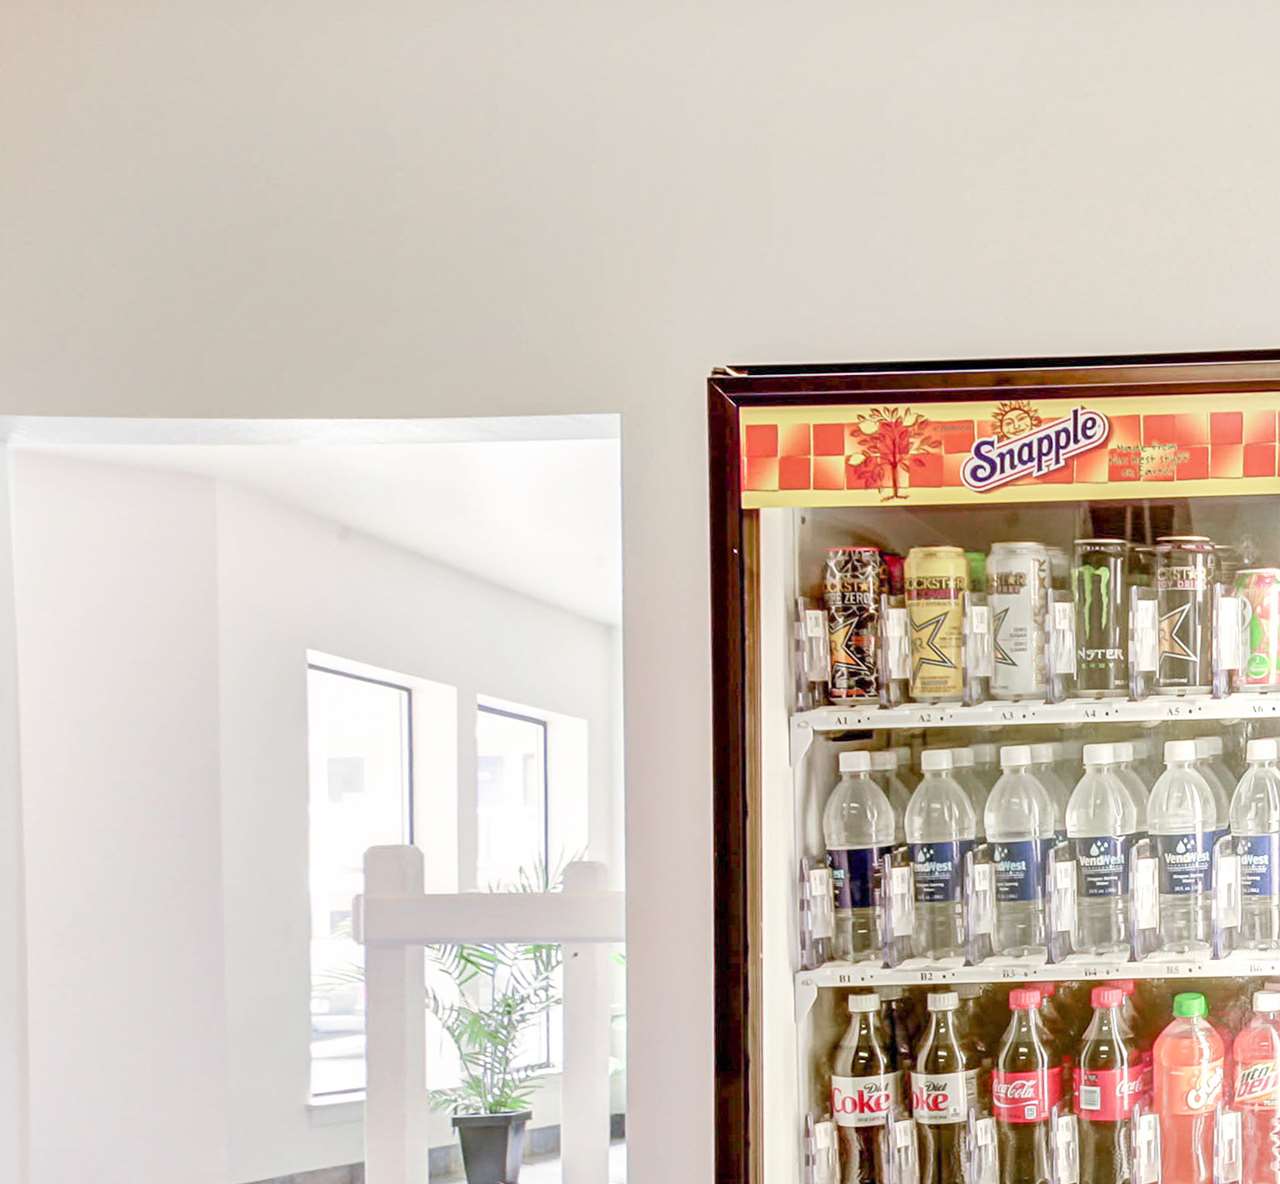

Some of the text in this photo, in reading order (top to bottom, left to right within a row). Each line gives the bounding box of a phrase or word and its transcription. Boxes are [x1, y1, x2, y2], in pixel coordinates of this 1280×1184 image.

[968, 409, 1097, 484] Snapple
[925, 1082, 948, 1093] Diet
[832, 1088, 890, 1114] Coke
[912, 1089, 949, 1112] oke
